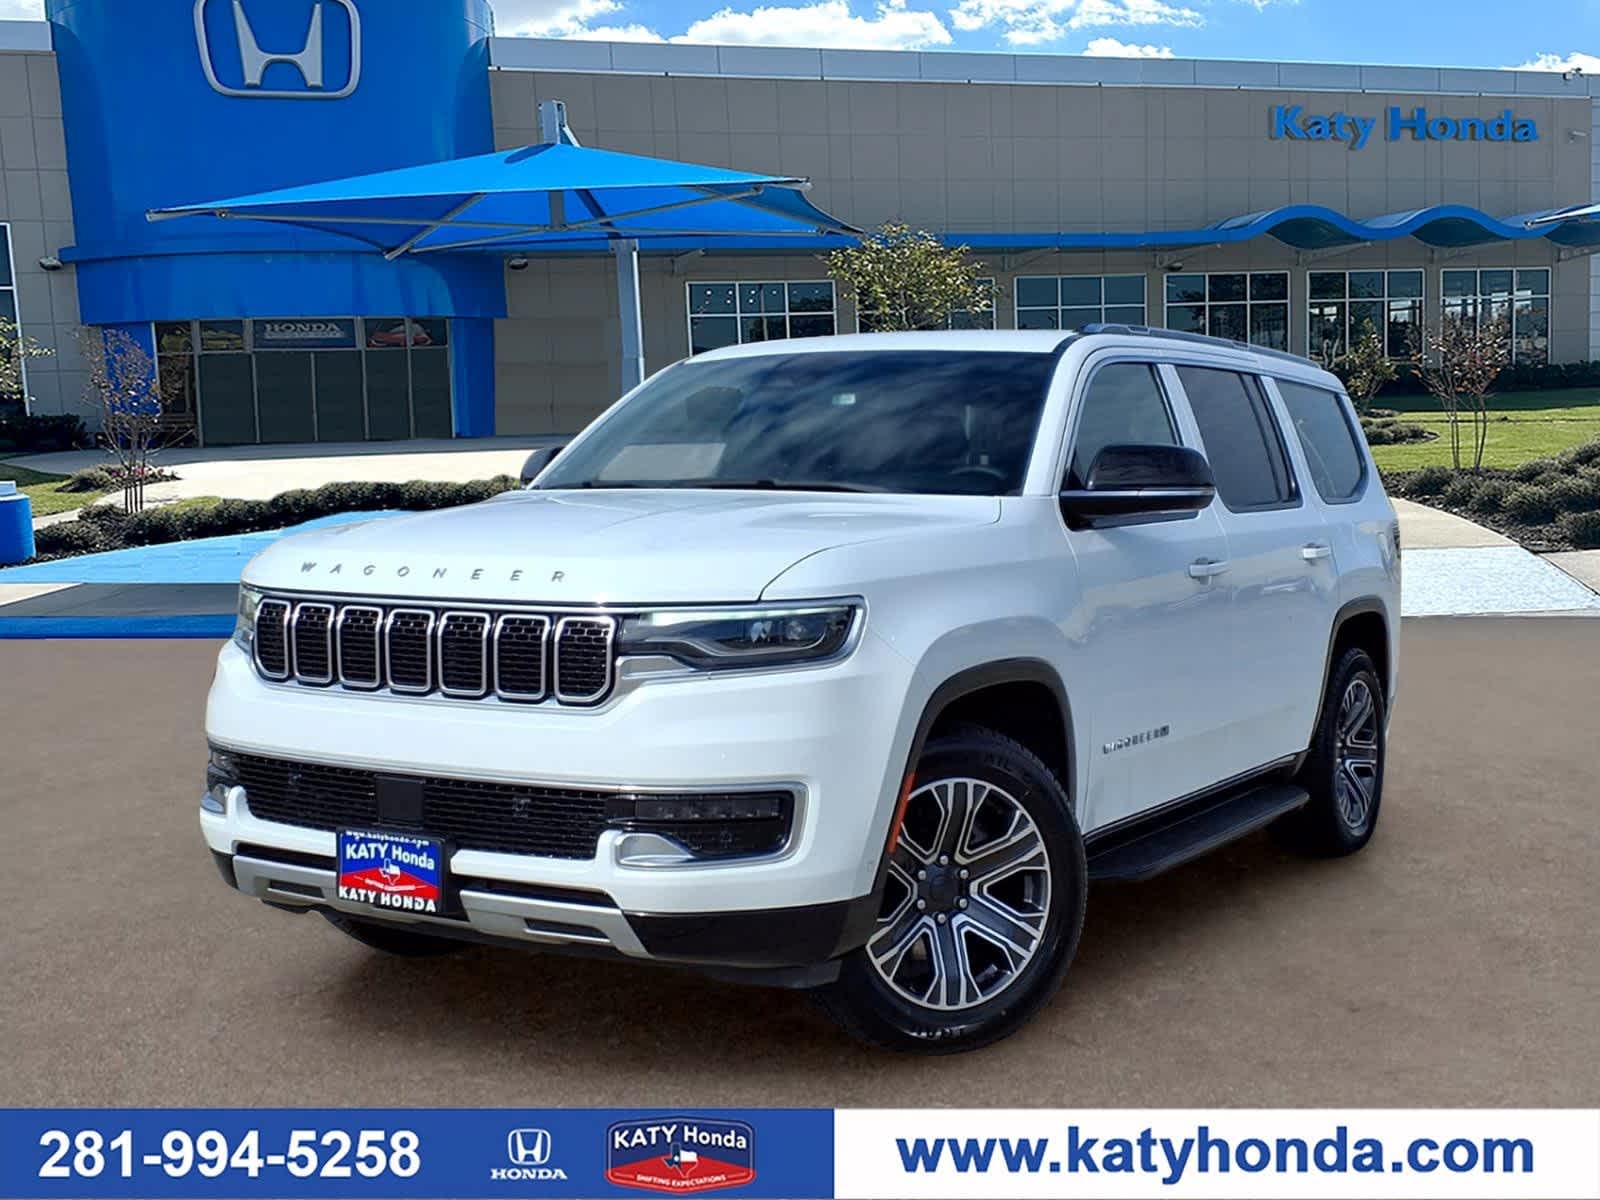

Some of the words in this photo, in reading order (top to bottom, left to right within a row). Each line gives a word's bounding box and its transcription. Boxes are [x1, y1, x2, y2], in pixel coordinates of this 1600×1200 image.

[1269, 104, 1376, 150] Katy
[1384, 106, 1540, 142] Honda
[264, 323, 340, 332] HONDA
[300, 561, 565, 583] WAGONEER
[345, 842, 388, 860] KATY
[391, 845, 435, 870] Honda
[339, 886, 376, 903] KATY
[380, 892, 436, 913] HONDA
